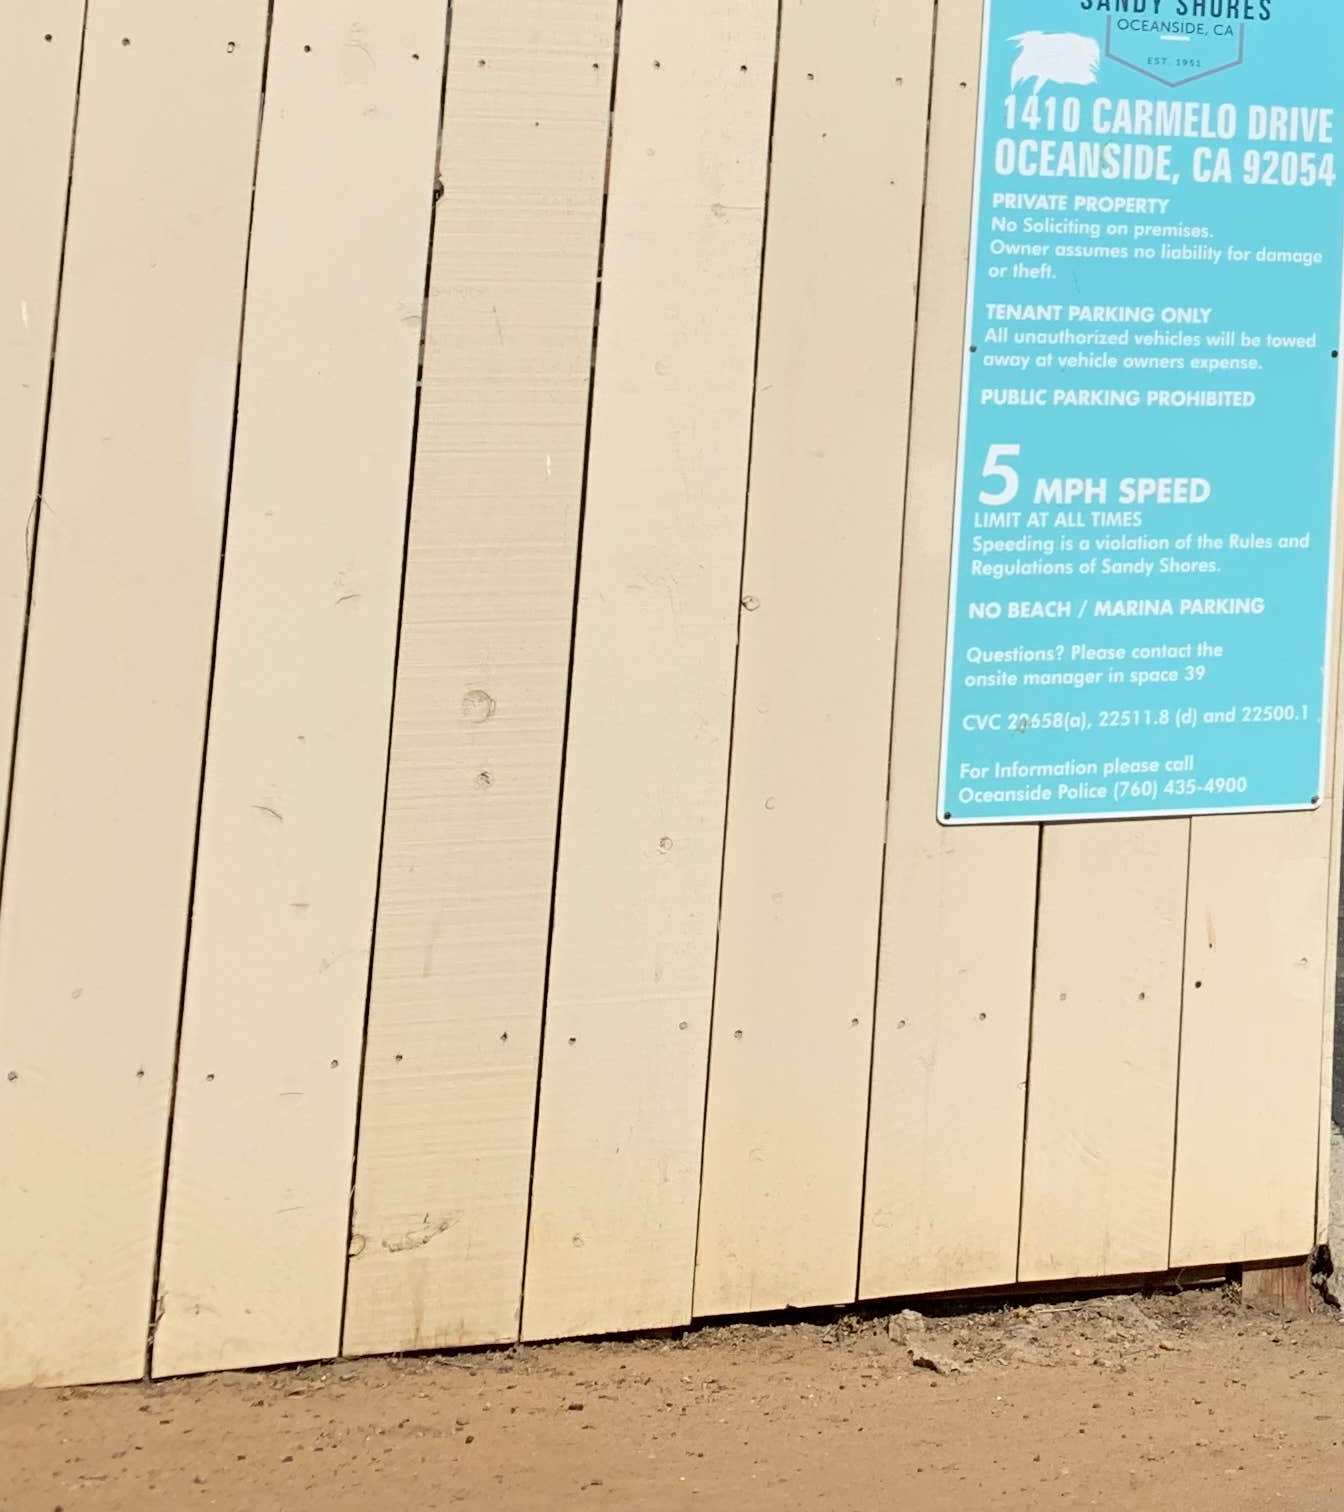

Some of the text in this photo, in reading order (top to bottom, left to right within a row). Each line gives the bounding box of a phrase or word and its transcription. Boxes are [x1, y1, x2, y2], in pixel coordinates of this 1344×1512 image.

[1117, 19, 1233, 36] OCEANSIDE, CA
[1005, 95, 1333, 143] 1410 CARMELO DRIVE
[995, 138, 1336, 186] OCEANSIDE, CA 92054
[993, 194, 1169, 212] PRIVATE PROPERTY
[992, 217, 1213, 238] No Soliciting on premises.
[990, 240, 1322, 266] Owner assumes no liability for damage
[989, 263, 1055, 278] or theft.
[986, 304, 1210, 323] TENANT PARKING ONLY
[985, 328, 1316, 347] All unauthorized vehicles will be towed
[984, 352, 1262, 371] away at vehicle owners expense.
[982, 389, 1254, 406] PUBLIC PARKING PROHIBITED
[979, 444, 1210, 505] 5 MPH SPEED
[975, 512, 1141, 527] LIMIT AT ALL TIMES
[973, 533, 1309, 555] Speeding is a violation of the Rules and
[972, 558, 1220, 579] Regulations of Sandy Shores.
[969, 602, 1001, 618] NO
[1008, 602, 1071, 618] BEACH
[1095, 600, 1173, 616] MARINA
[1181, 598, 1264, 614] PARKING
[967, 642, 1223, 664] Questions? Please contact the
[965, 666, 1205, 687] onsite manager in space 39
[963, 714, 1001, 730] CVC
[1099, 709, 1169, 726] 22511.8
[1176, 708, 1196, 727] (d)
[1203, 707, 1235, 723] and
[1242, 705, 1307, 721] 22500.1
[960, 756, 1193, 779] For Information please call
[959, 777, 1247, 803] Oceanside Police (760) 435-4900
